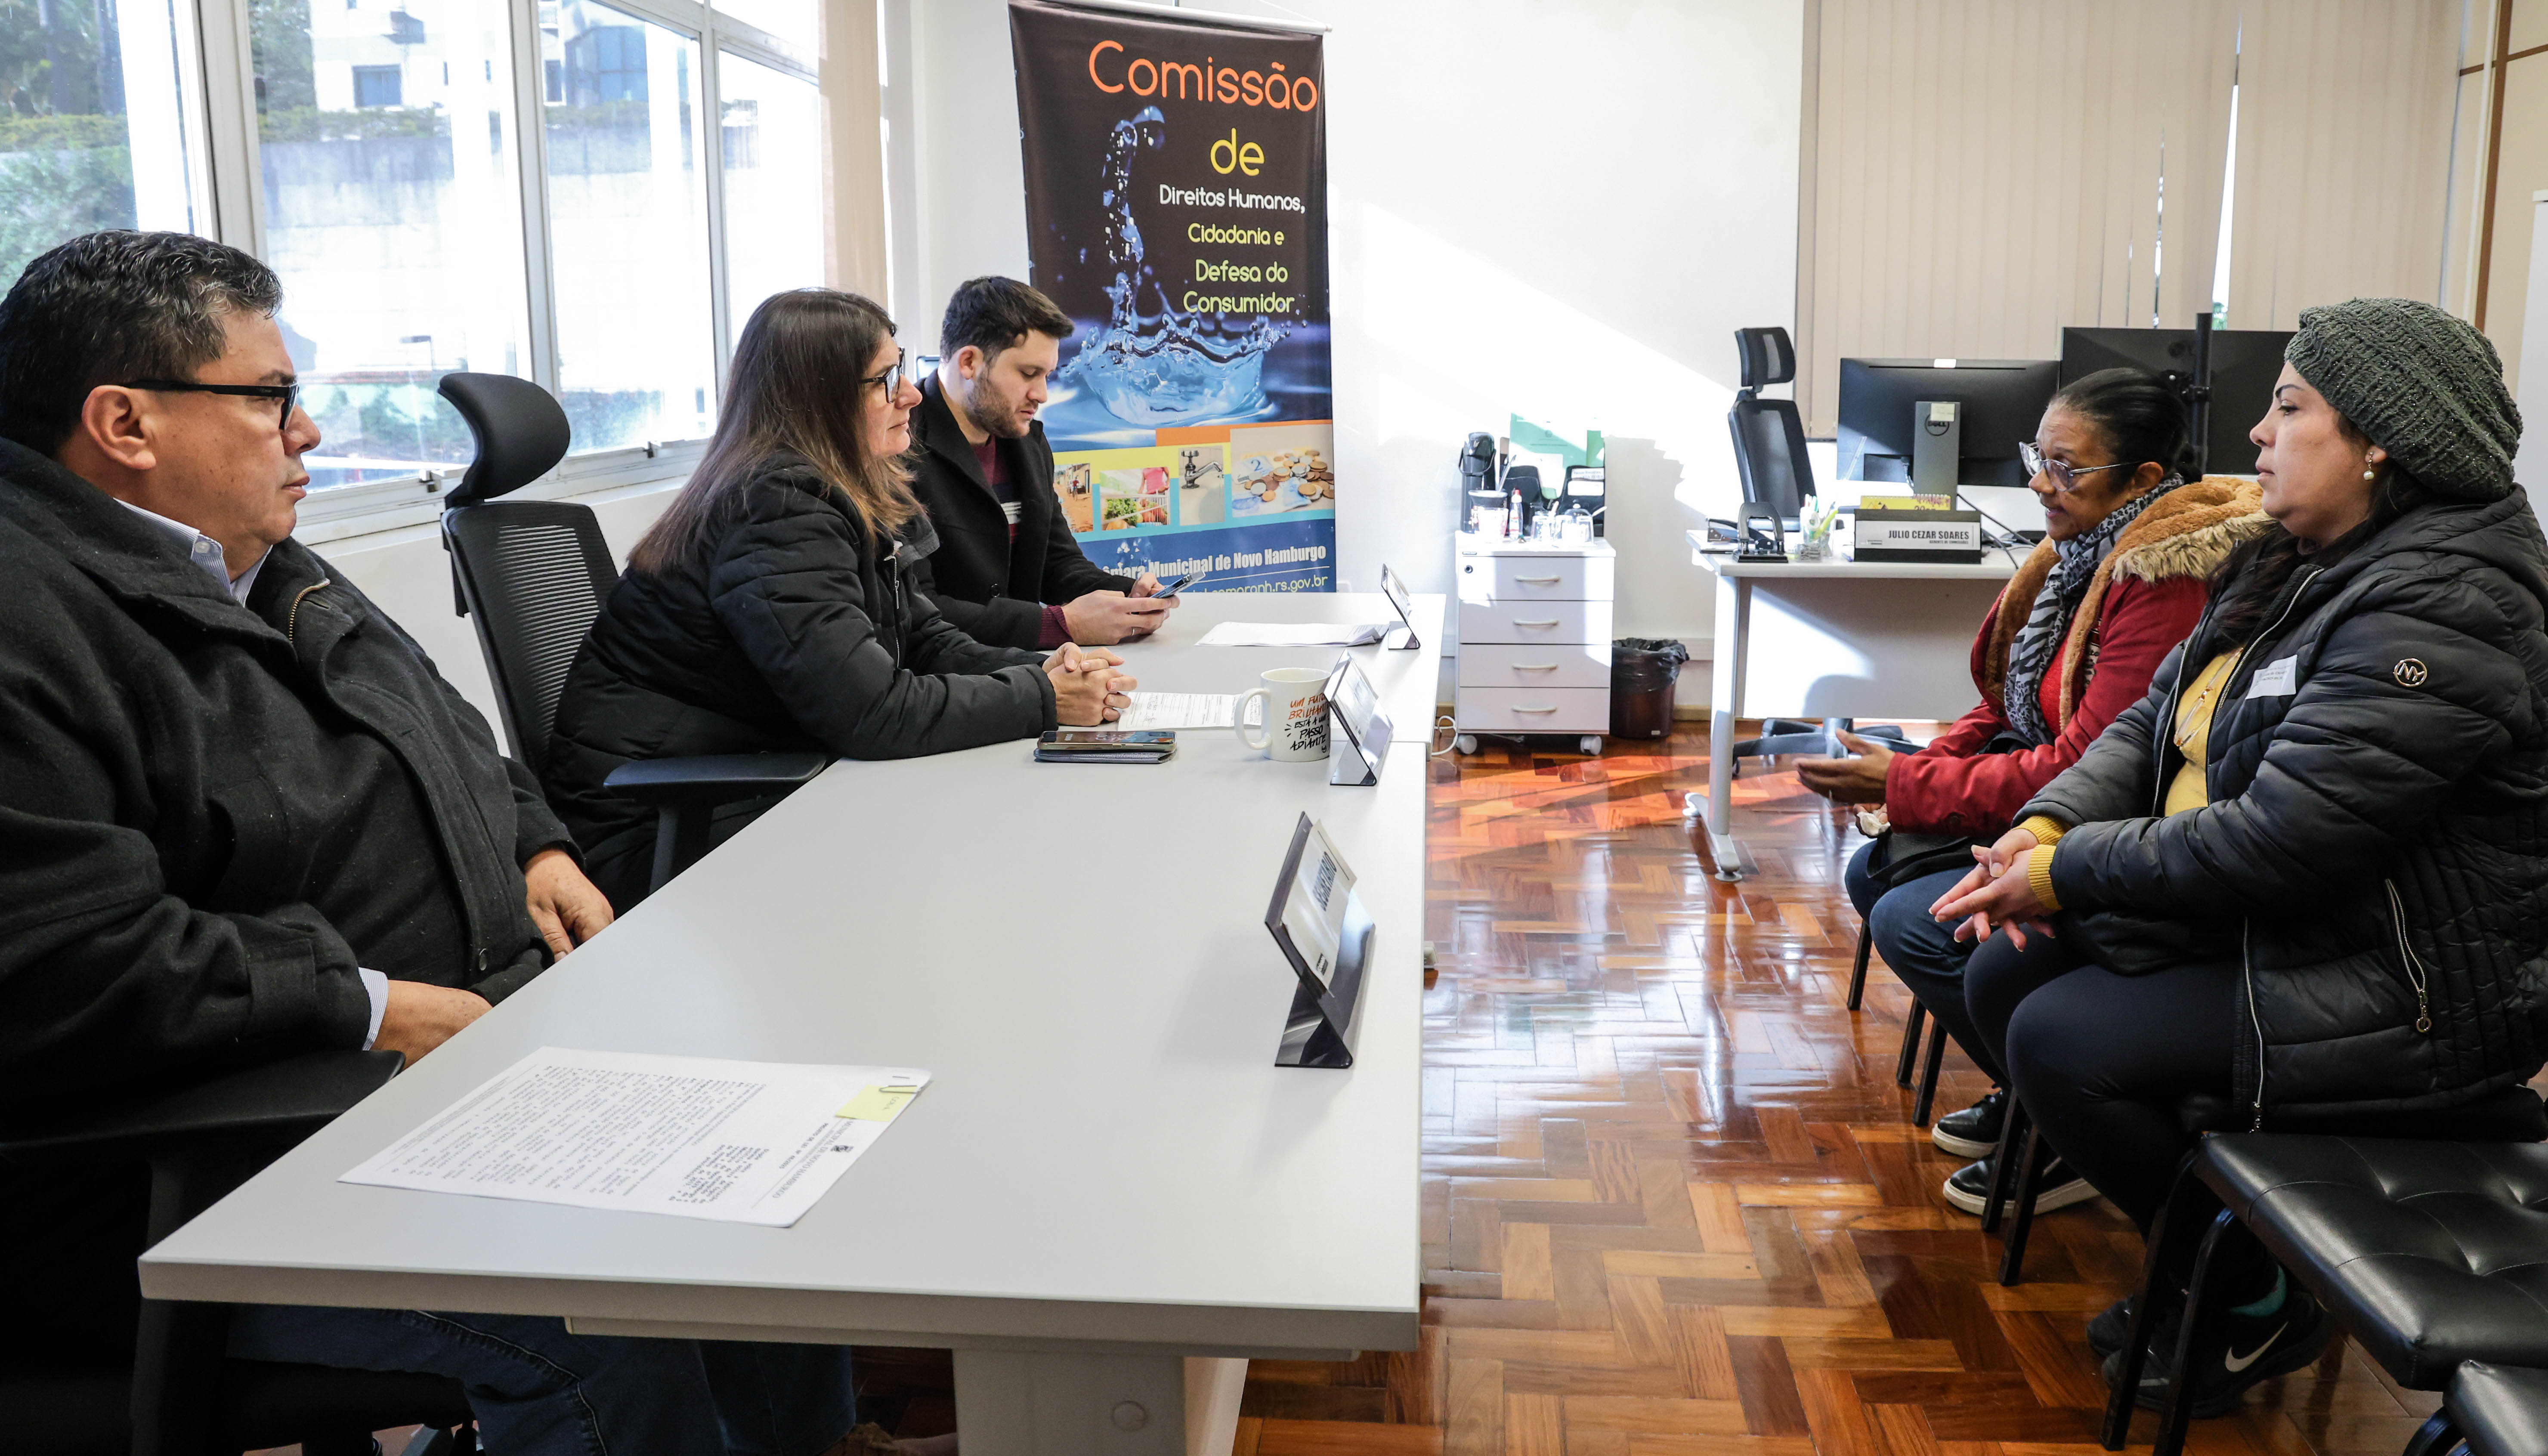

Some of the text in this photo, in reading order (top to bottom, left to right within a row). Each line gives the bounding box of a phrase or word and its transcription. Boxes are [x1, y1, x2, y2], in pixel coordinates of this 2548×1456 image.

[1089, 40, 1318, 111] Comissão
[1210, 128, 1265, 176] de
[1160, 184, 1306, 214] Direitos Humanos,
[1188, 223, 1284, 246] Cidadania e
[1196, 260, 1288, 283] Defesa do
[1183, 291, 1294, 313] Consumidor
[1889, 530, 1969, 540] JULIO CEZAR SOARES
[1148, 555, 1212, 577] Municipal
[1215, 553, 1231, 571] de
[1234, 551, 1262, 569] Novo
[1265, 545, 1326, 565] Hamburgo
[1290, 697, 1305, 708] UM
[1295, 716, 1311, 728] ESTÁ
[1313, 717, 1318, 725] A
[1300, 724, 1323, 739] PASSO
